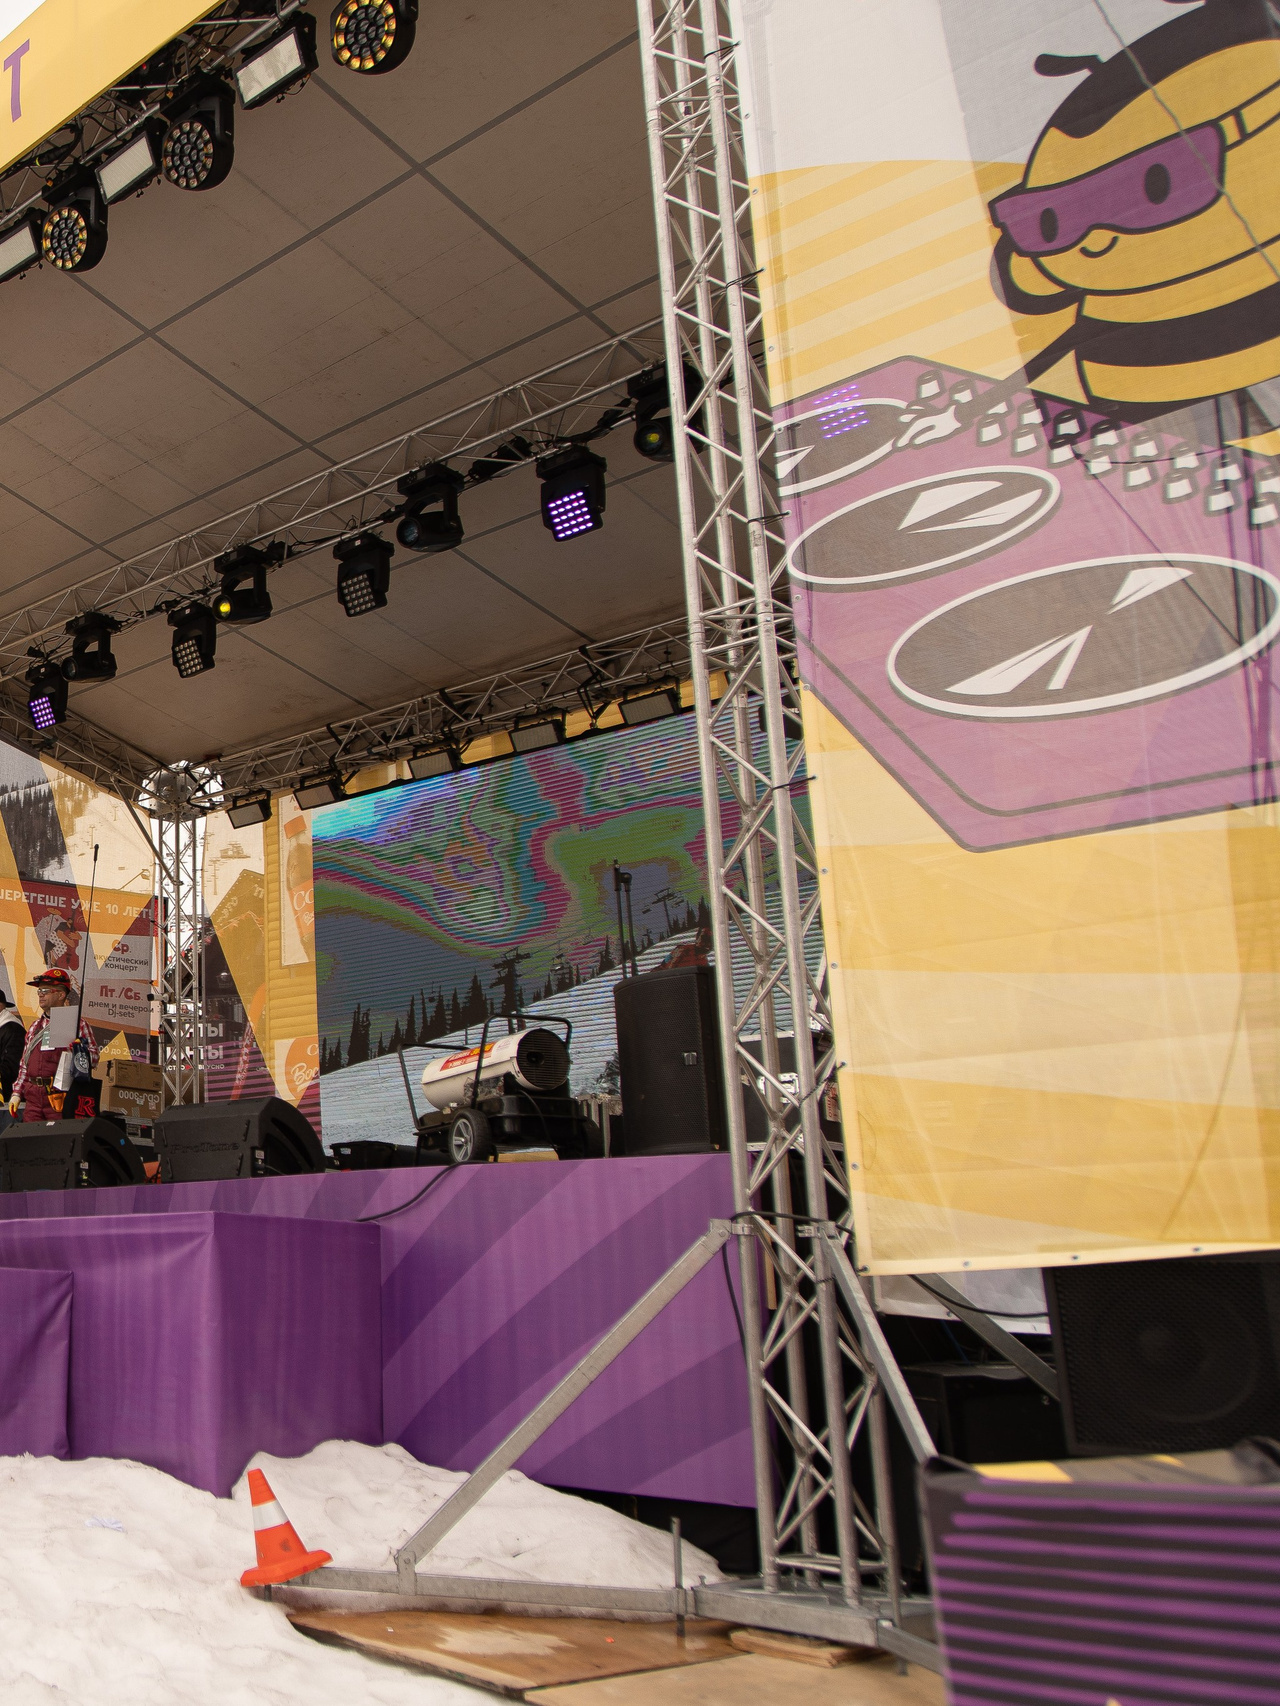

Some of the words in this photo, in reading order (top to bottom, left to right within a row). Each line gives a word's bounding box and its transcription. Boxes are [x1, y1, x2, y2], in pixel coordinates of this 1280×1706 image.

[71, 898, 101, 913] УЖЕ
[105, 903, 119, 916] 10
[93, 952, 149, 967] акустический
[104, 961, 139, 973] концерт
[88, 1000, 110, 1010] днем
[111, 1002, 117, 1010] и
[118, 1090, 160, 1103] CDJ-3000
